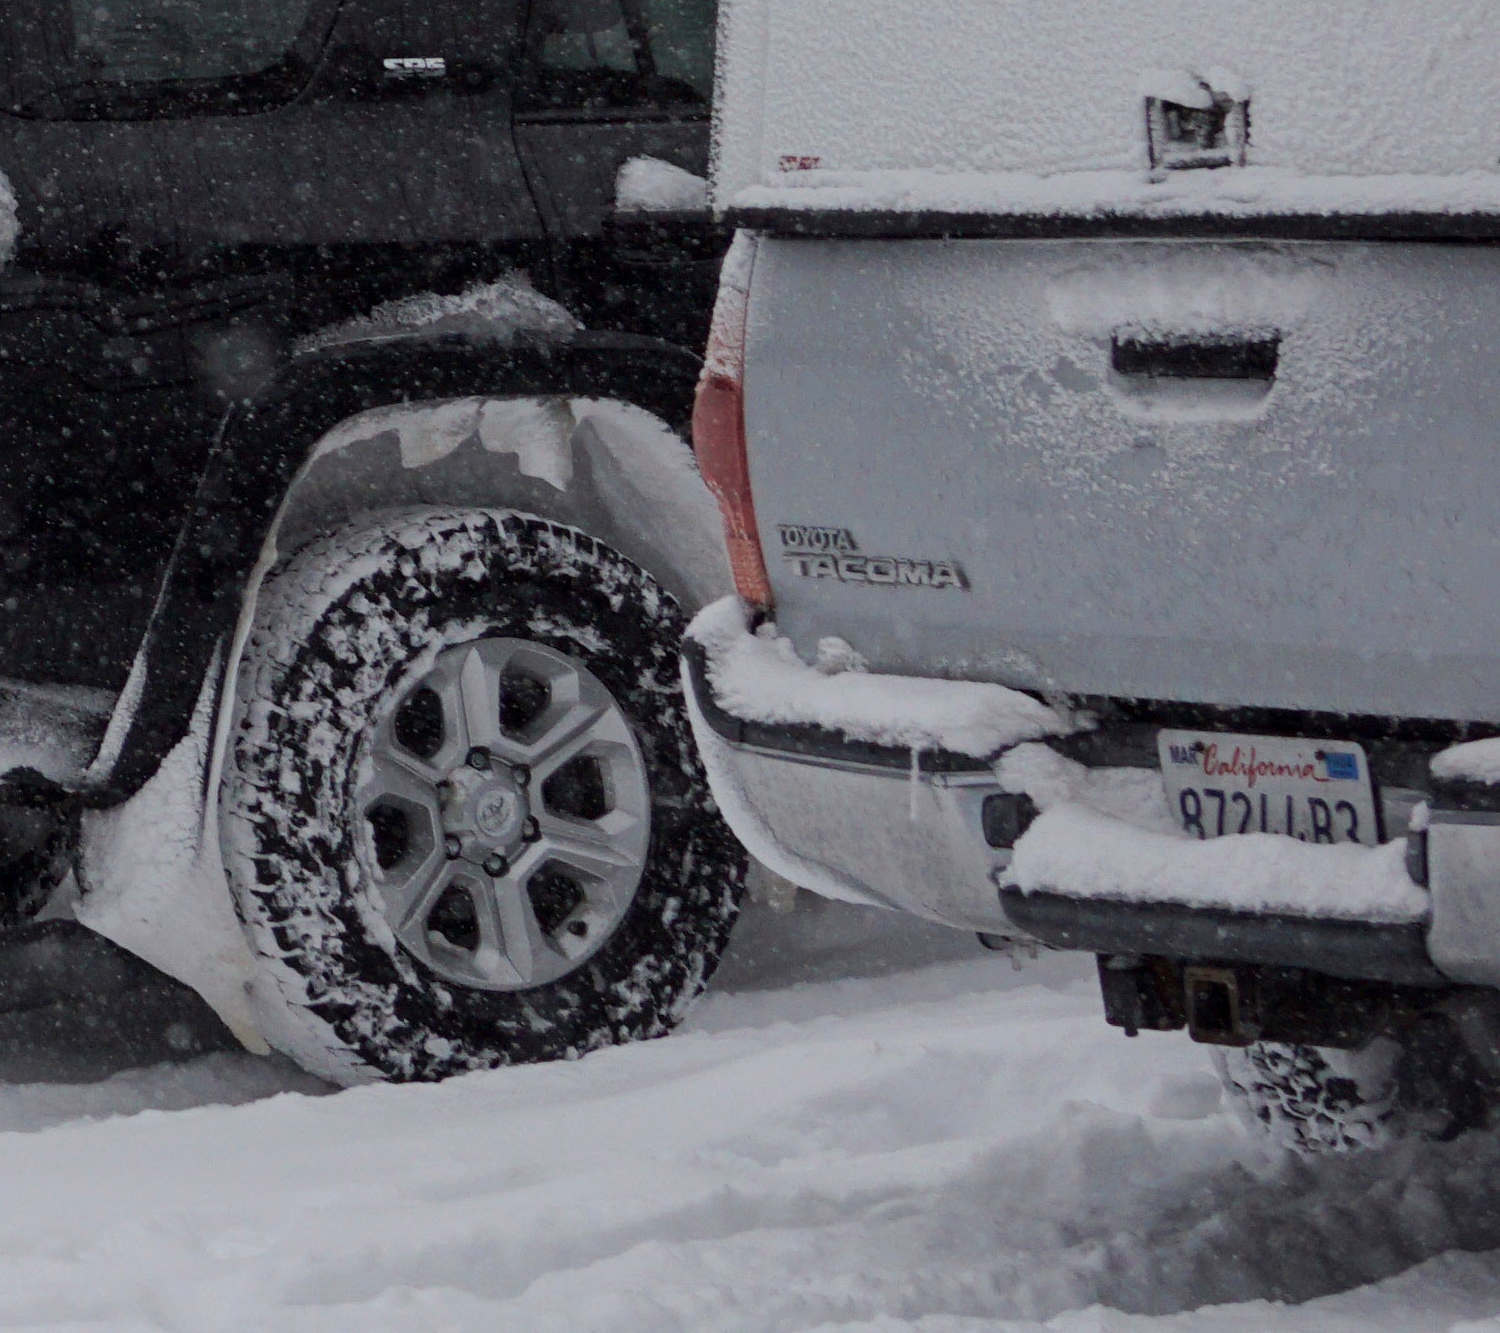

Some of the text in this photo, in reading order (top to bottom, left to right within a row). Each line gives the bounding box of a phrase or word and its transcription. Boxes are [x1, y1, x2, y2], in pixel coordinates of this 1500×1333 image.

[777, 524, 859, 551] TOYOTA
[782, 551, 972, 591] TACOMA
[1202, 742, 1332, 788] California
